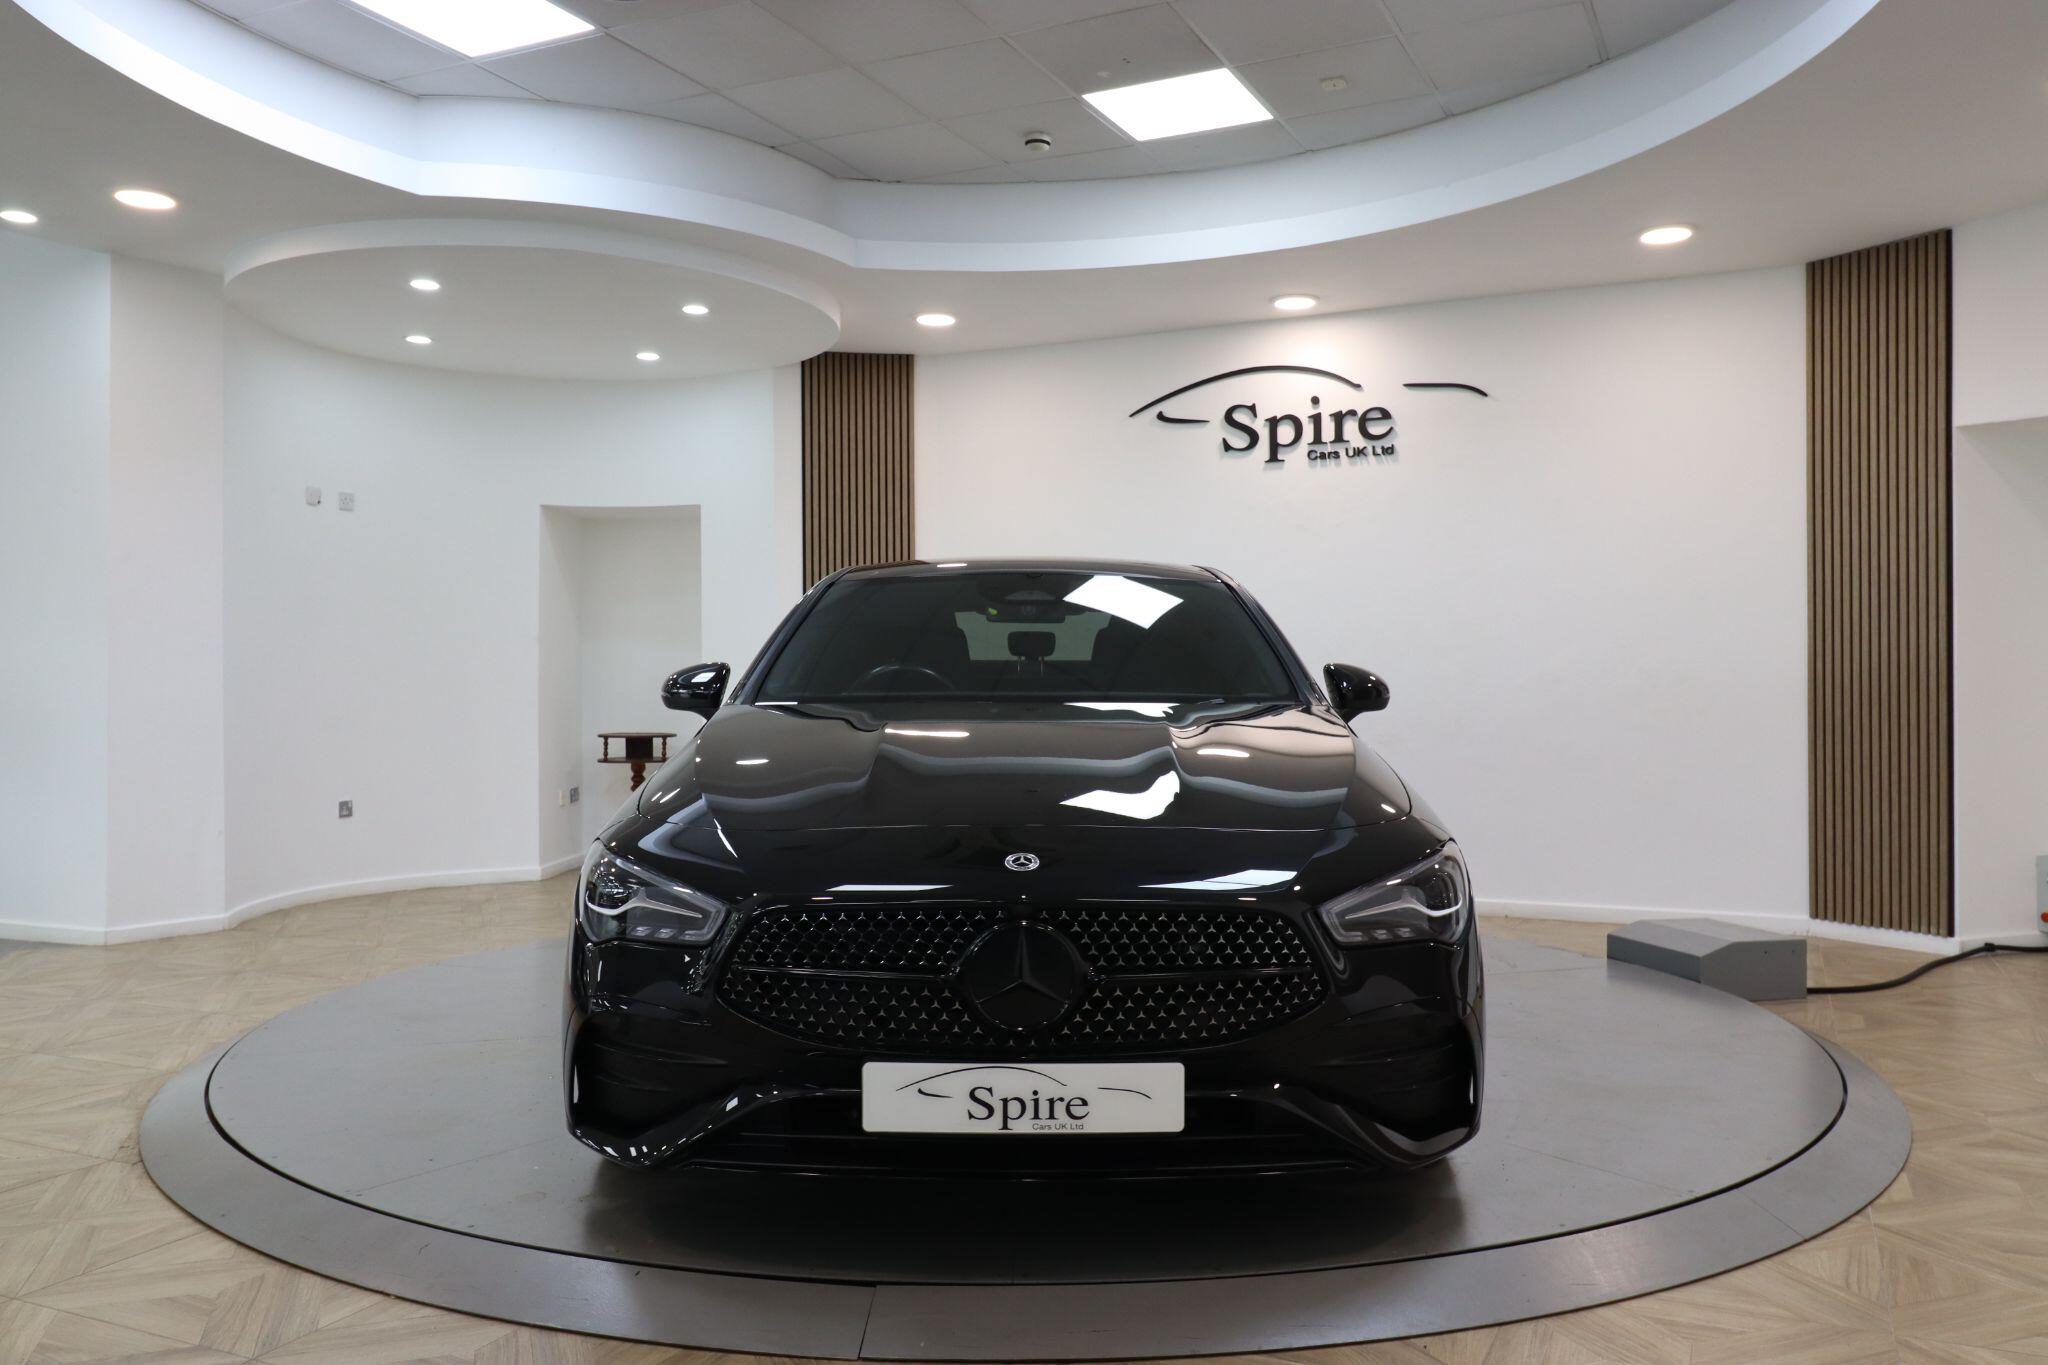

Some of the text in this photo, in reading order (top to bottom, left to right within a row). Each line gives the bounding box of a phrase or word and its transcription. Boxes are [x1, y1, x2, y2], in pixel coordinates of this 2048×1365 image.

[1222, 396, 1394, 463] Spire
[1307, 444, 1395, 461] Cars UK Ltd
[967, 1086, 1090, 1130] Spire
[1032, 1122, 1084, 1131] Cars UK Ltd
